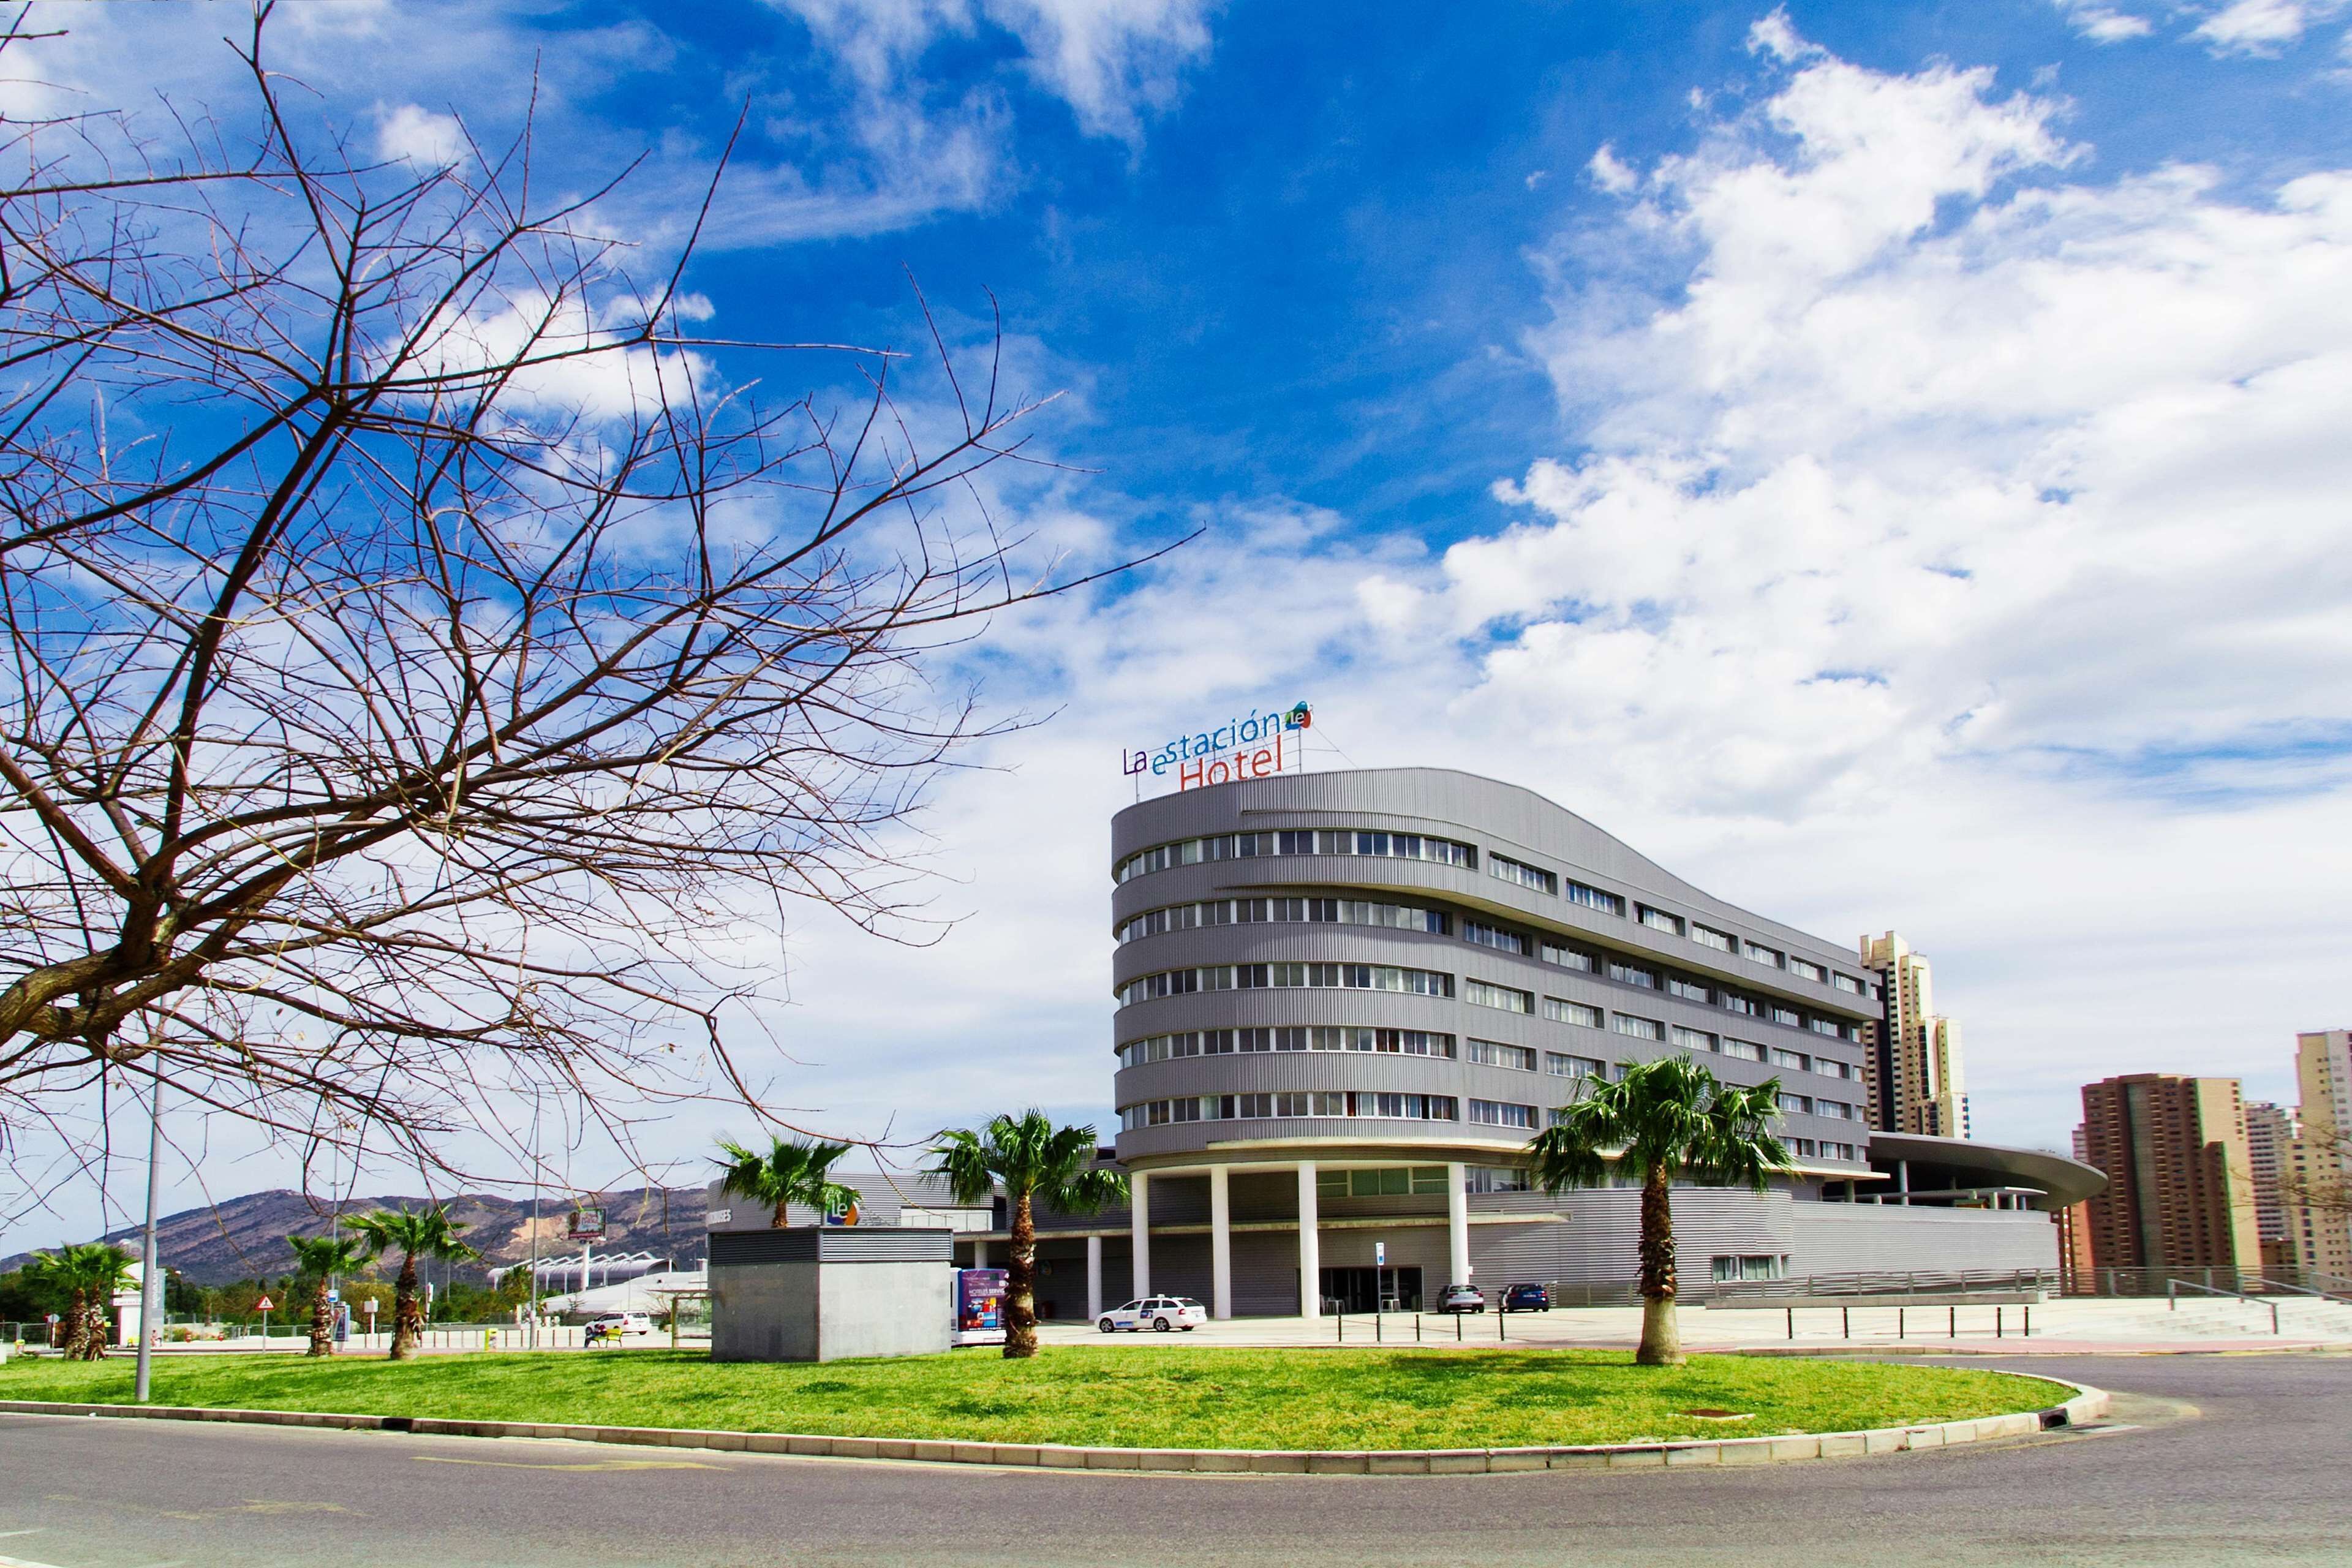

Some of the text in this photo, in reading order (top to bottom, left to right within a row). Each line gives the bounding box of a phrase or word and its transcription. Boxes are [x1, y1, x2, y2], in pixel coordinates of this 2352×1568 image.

[1123, 709, 1281, 775] La estación
[1180, 734, 1283, 792] Hotel
